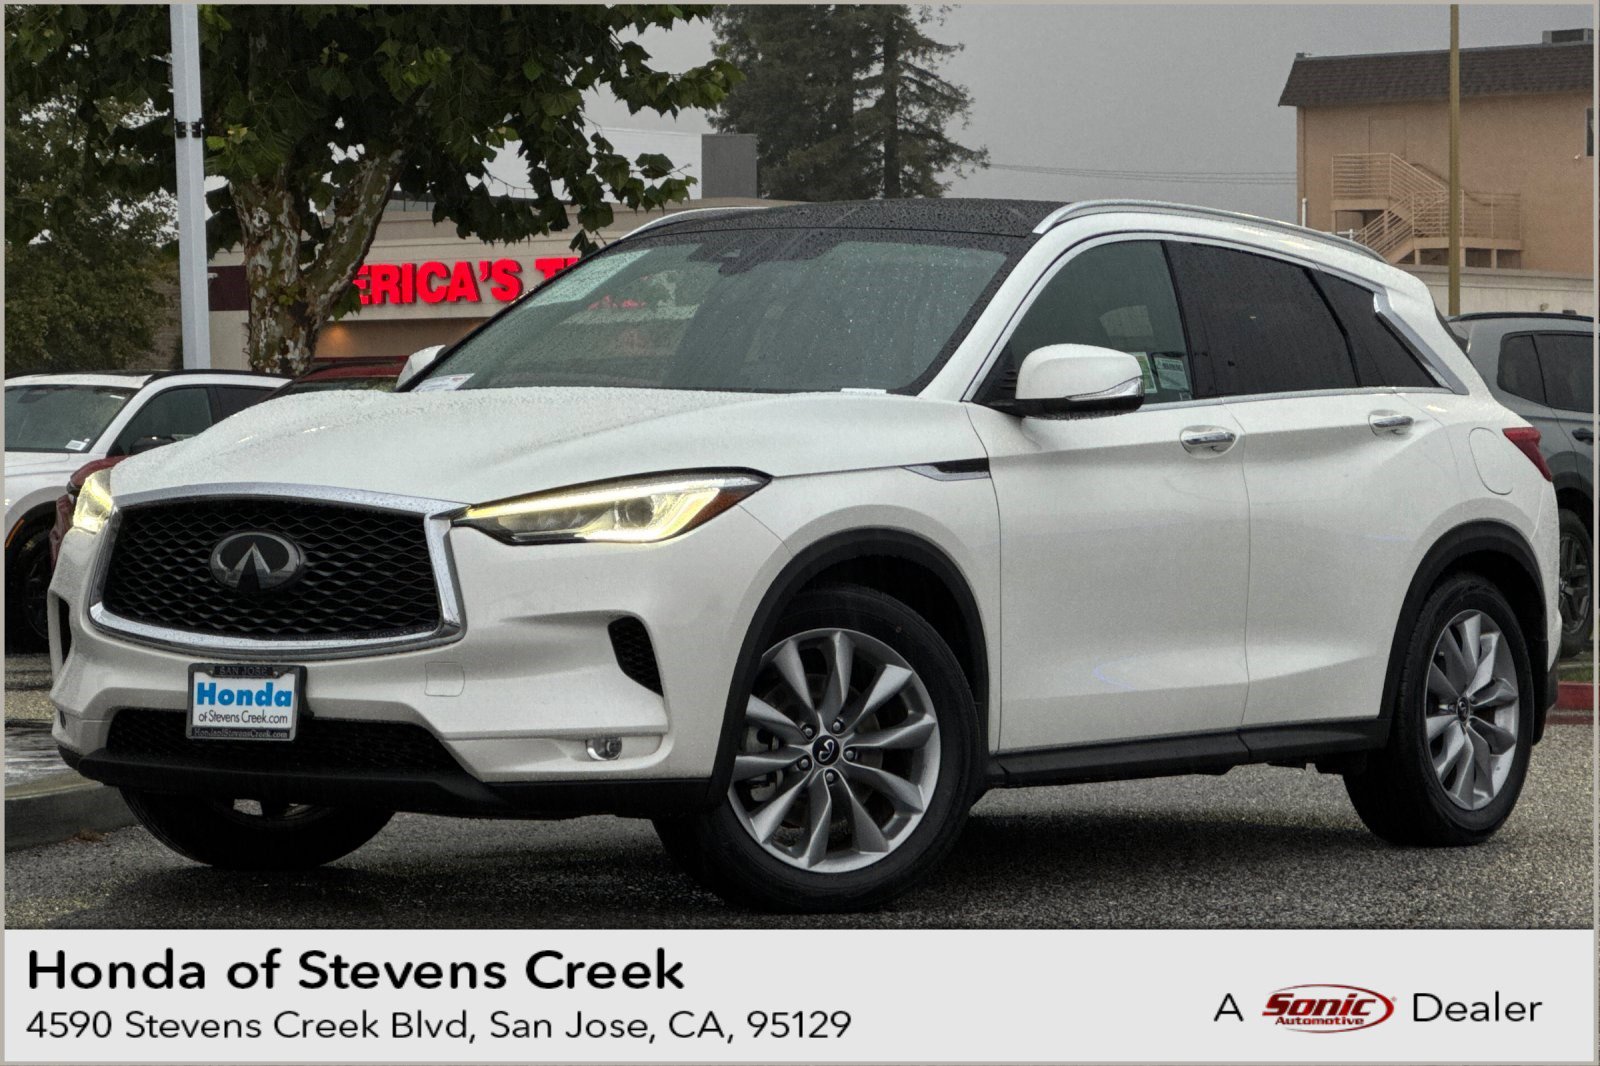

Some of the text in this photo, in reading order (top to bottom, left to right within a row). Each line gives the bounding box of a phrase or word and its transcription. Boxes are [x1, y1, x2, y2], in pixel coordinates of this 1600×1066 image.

[220, 666, 267, 676] SAN JOSE
[197, 682, 292, 707] Honda
[199, 711, 208, 722] of
